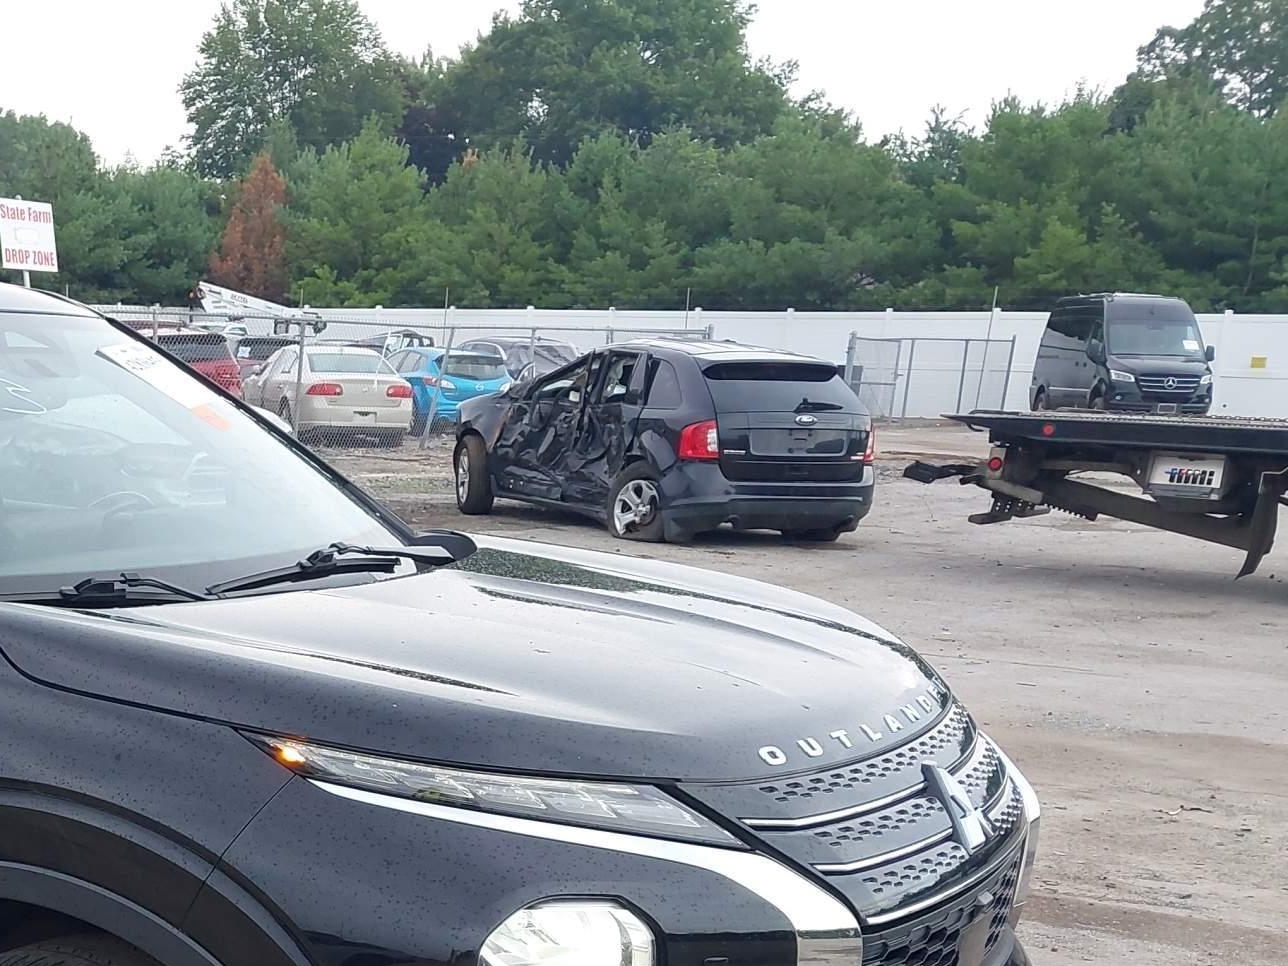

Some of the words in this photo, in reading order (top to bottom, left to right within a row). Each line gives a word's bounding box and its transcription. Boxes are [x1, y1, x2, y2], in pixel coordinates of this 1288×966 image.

[0, 203, 26, 221] State
[27, 206, 52, 224] Farm
[4, 247, 31, 265] DROP
[32, 250, 56, 267] ZONE
